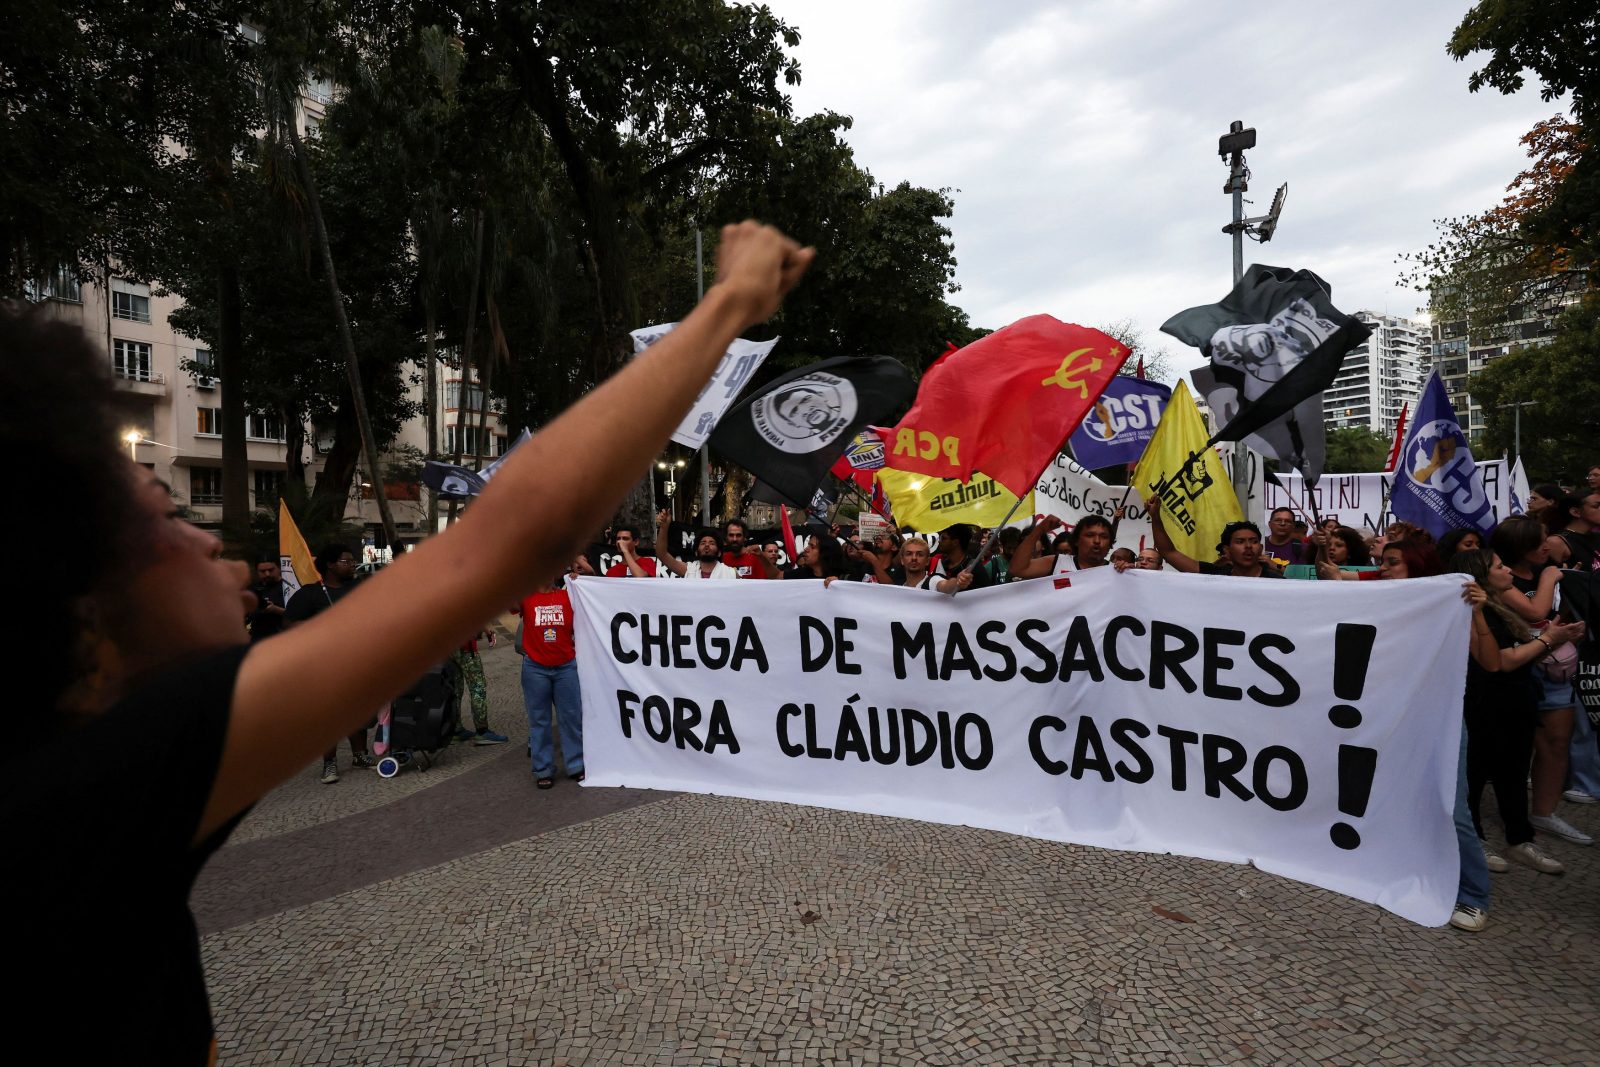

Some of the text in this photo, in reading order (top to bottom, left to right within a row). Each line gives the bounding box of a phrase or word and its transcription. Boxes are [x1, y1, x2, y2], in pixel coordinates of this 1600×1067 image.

[1102, 393, 1161, 433] CST
[541, 613, 564, 622] MNLM
[610, 611, 770, 674] CHEGA
[798, 615, 862, 676] DE
[616, 689, 741, 755] FORA
[775, 692, 994, 771] CLÁUDIO
